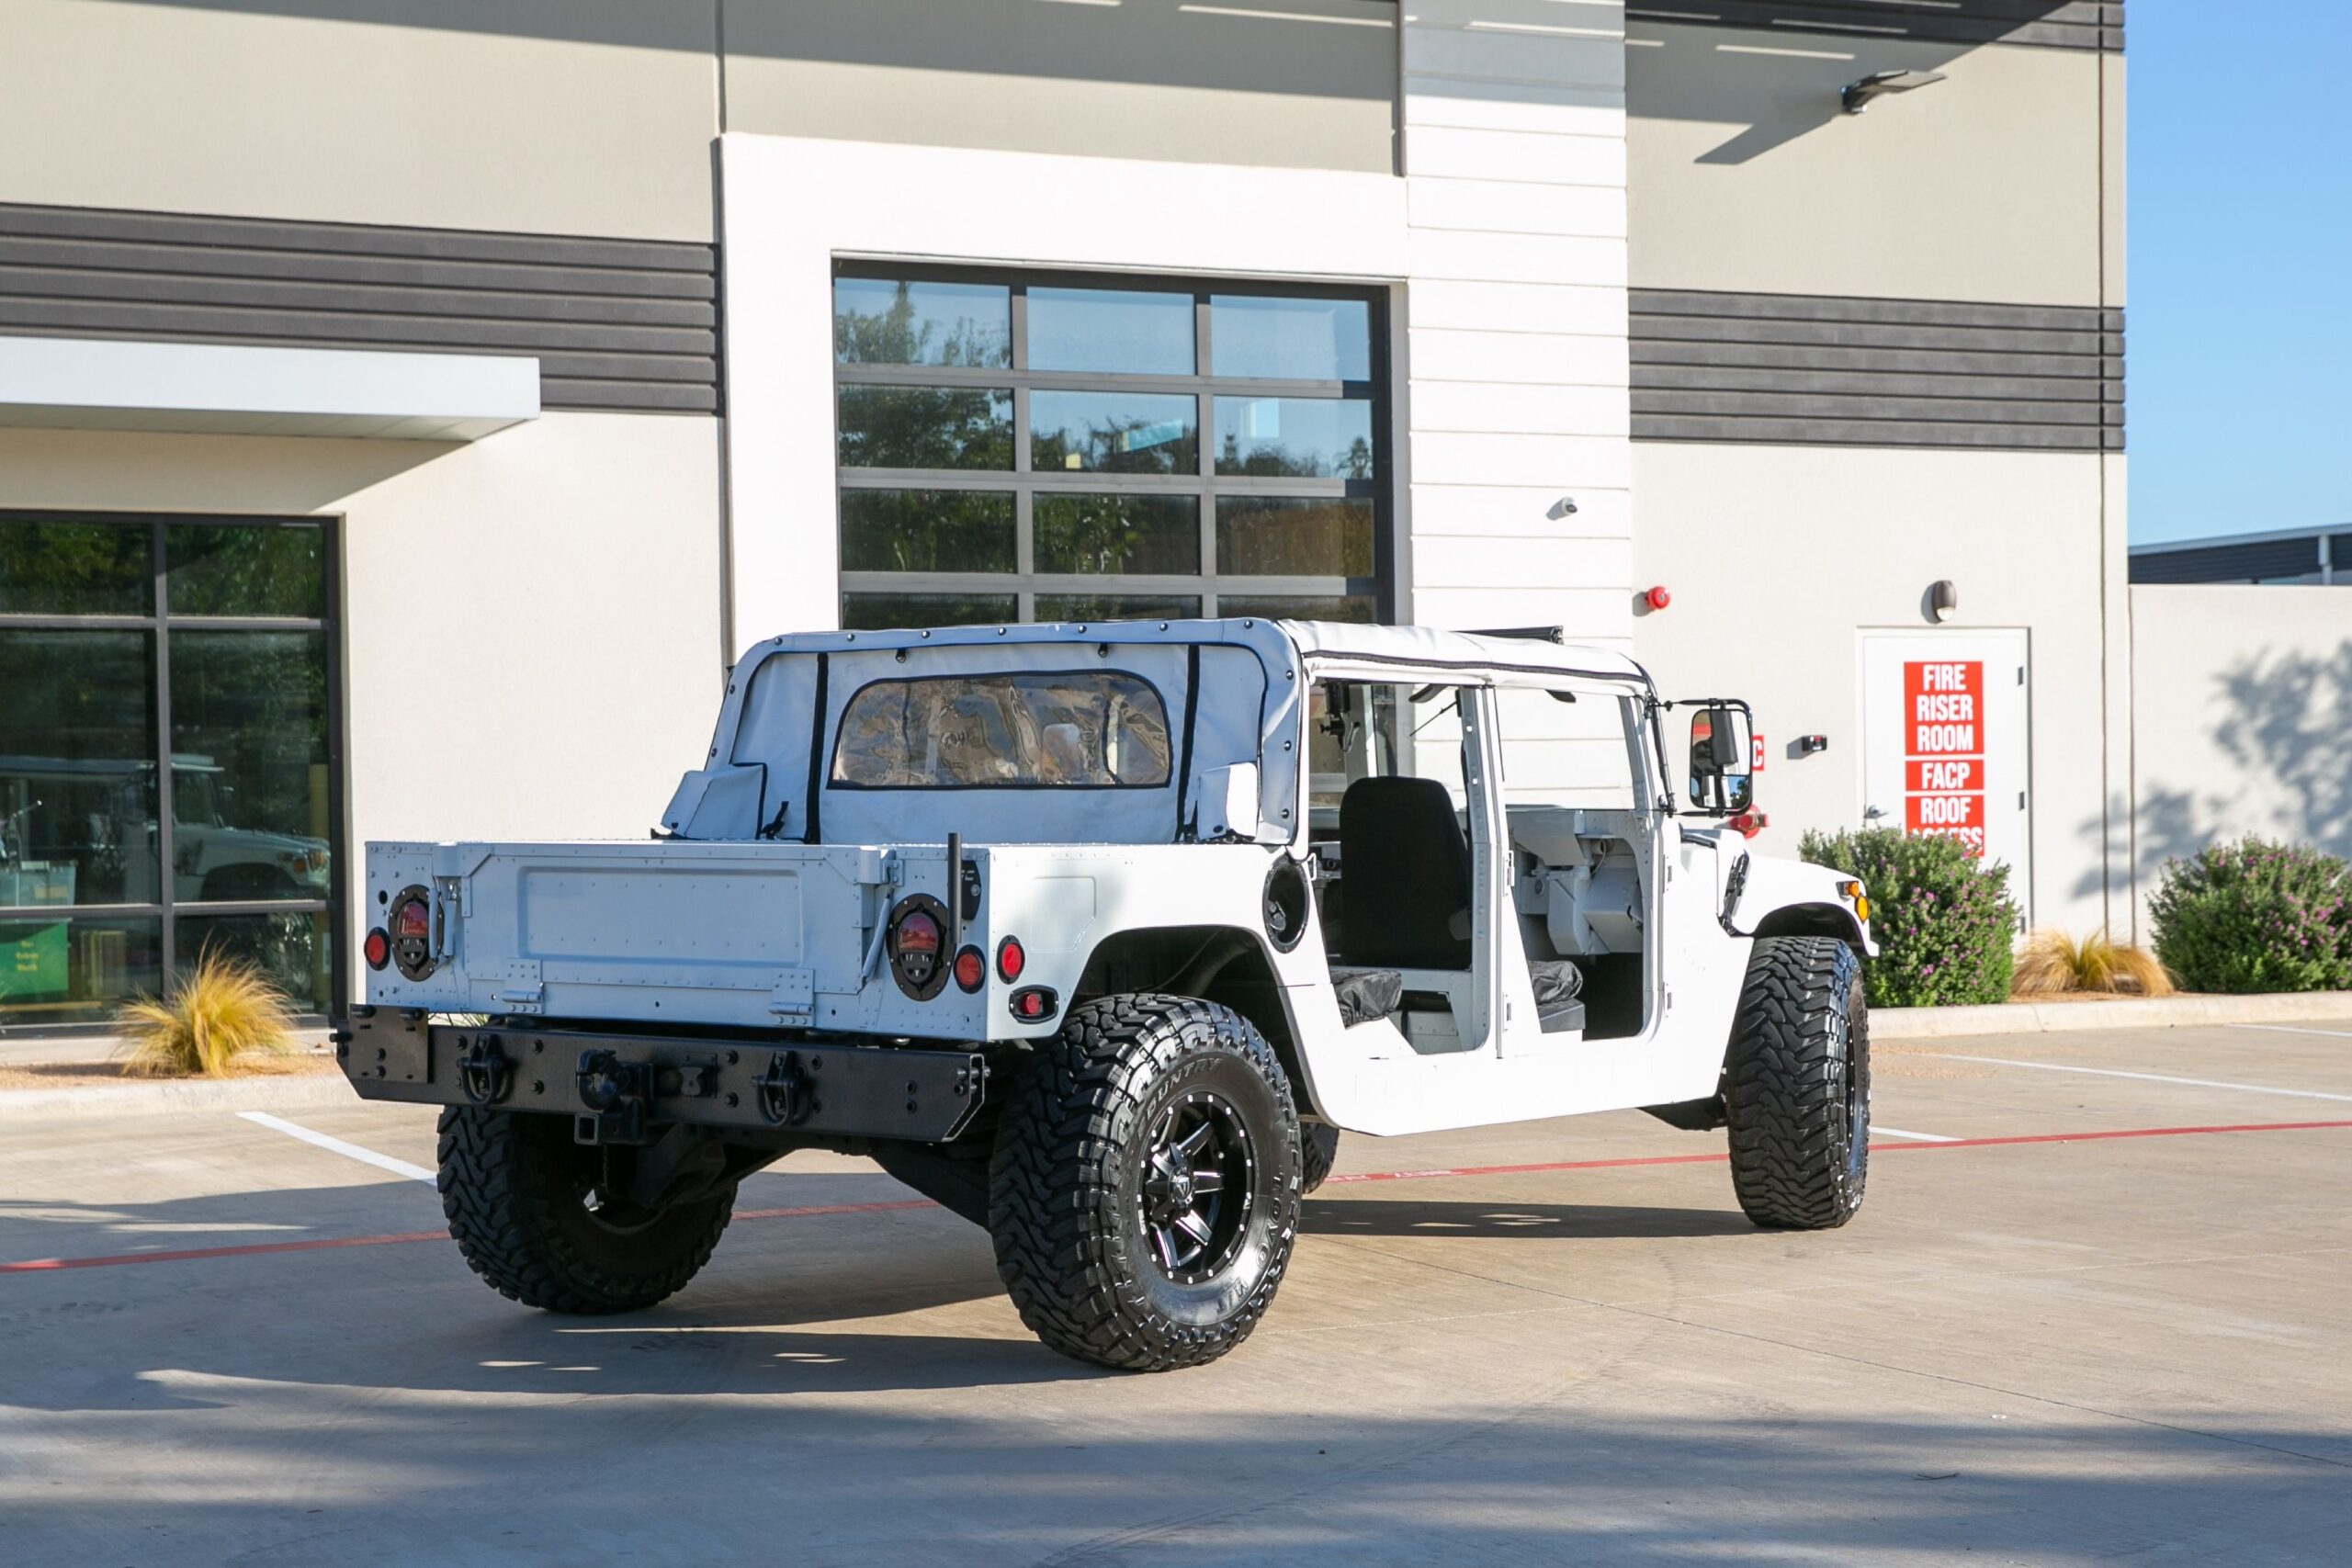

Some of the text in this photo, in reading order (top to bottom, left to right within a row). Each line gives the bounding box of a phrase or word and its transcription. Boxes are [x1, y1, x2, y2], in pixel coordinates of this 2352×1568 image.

[1923, 664, 1967, 691] FIRE
[1917, 694, 1973, 722] RISER
[1917, 724, 1974, 752] ROOM
[1921, 761, 1971, 789] FACP
[1920, 796, 1972, 824] ROOF
[1257, 1174, 1284, 1269] TOYO
